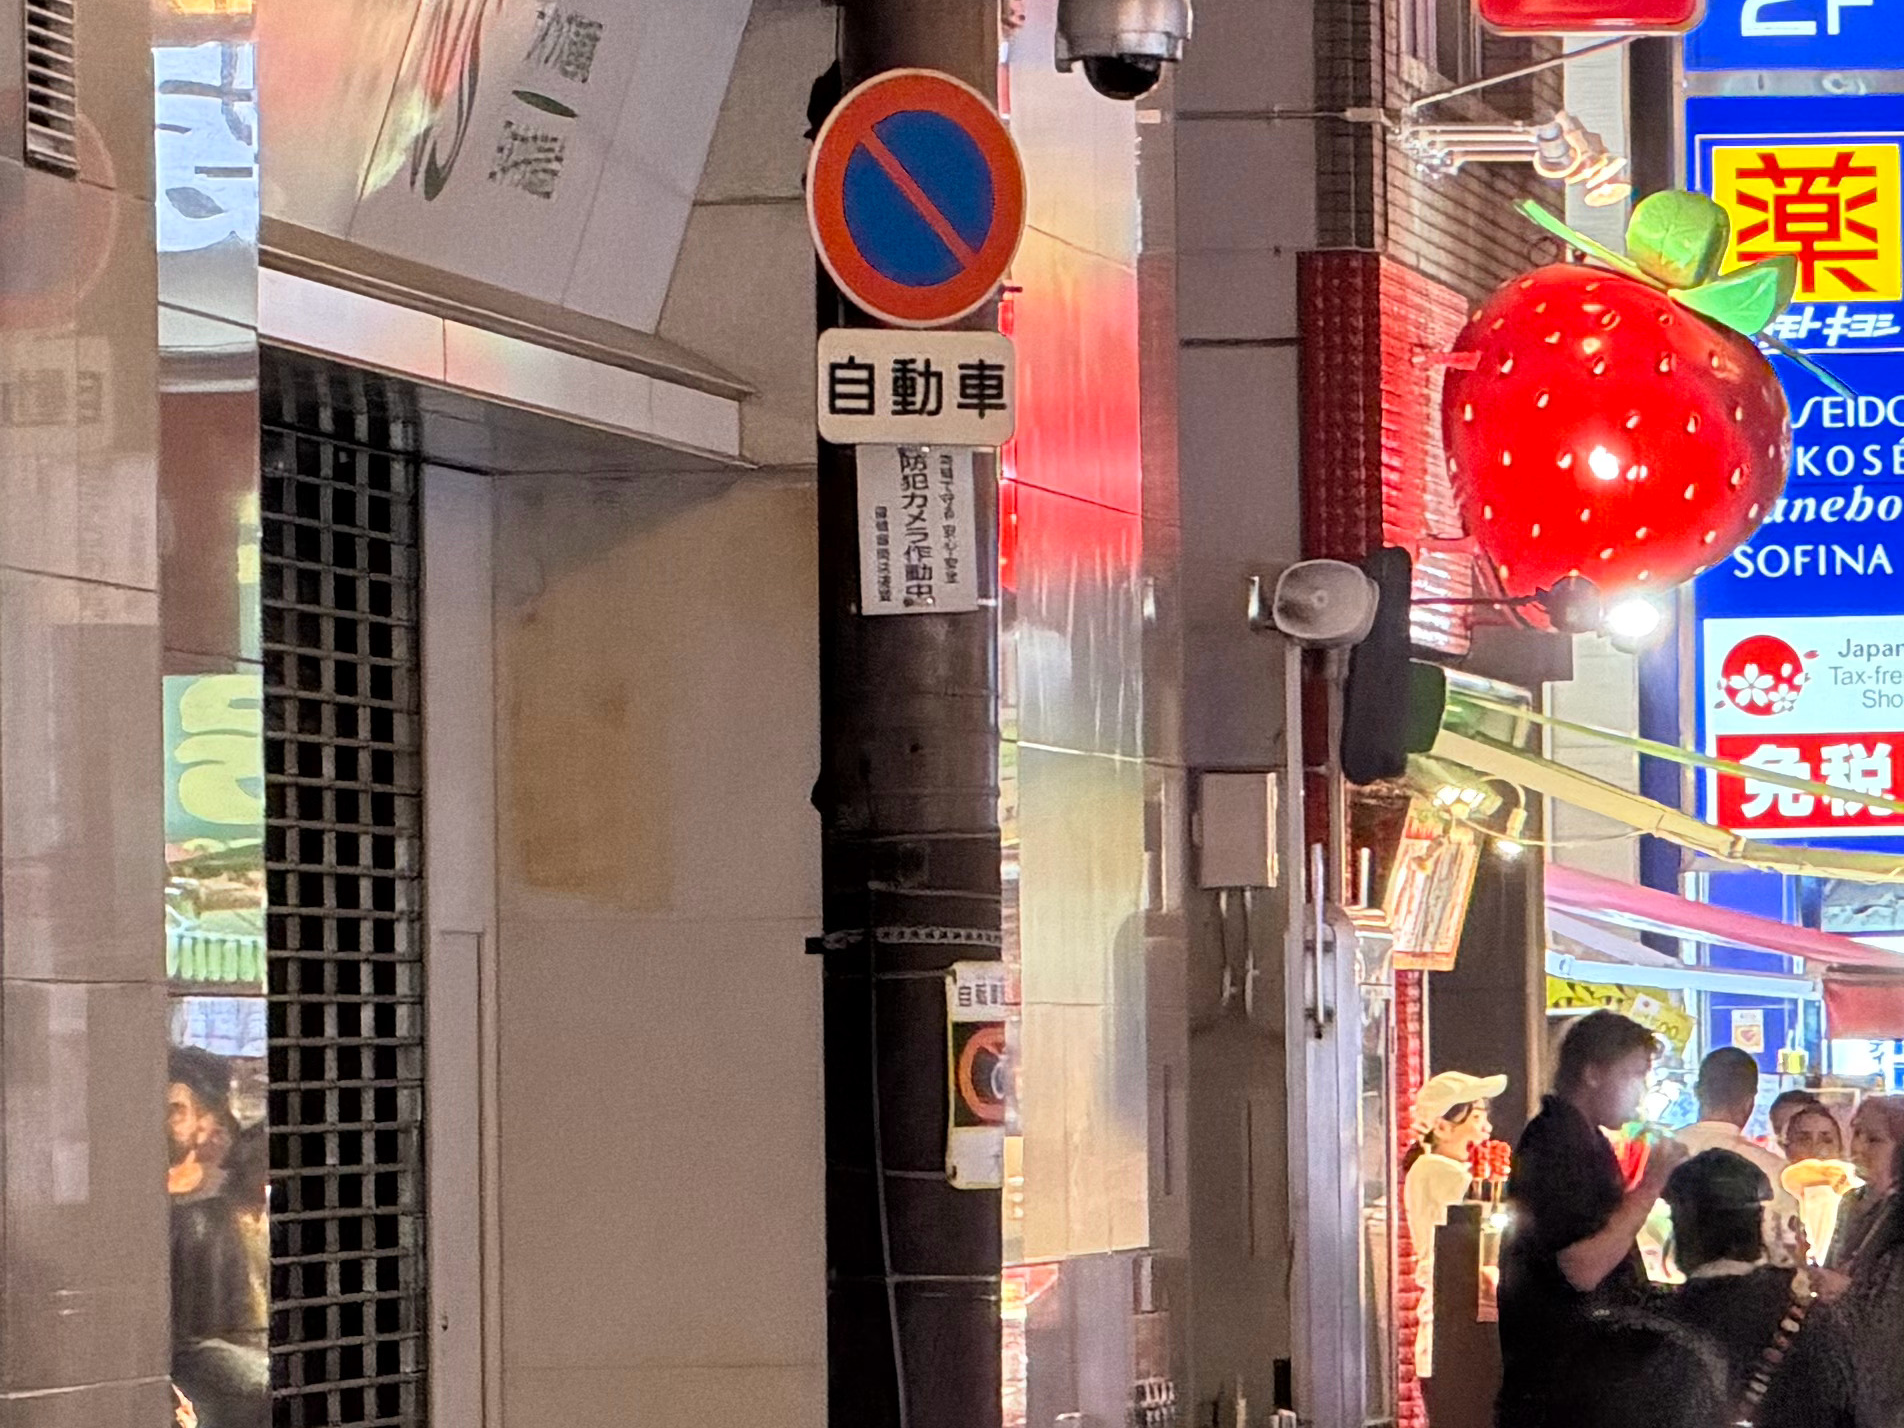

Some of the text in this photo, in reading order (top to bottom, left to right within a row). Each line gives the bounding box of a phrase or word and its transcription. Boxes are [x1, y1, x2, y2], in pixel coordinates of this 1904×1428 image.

[1735, 151, 1880, 294] 薬
[1764, 305, 1902, 348] モトキヨシ
[827, 354, 1007, 419] 自動車
[1763, 491, 1904, 524] anebo
[1732, 542, 1893, 579] SOFINA
[1738, 742, 1898, 820] 免税
